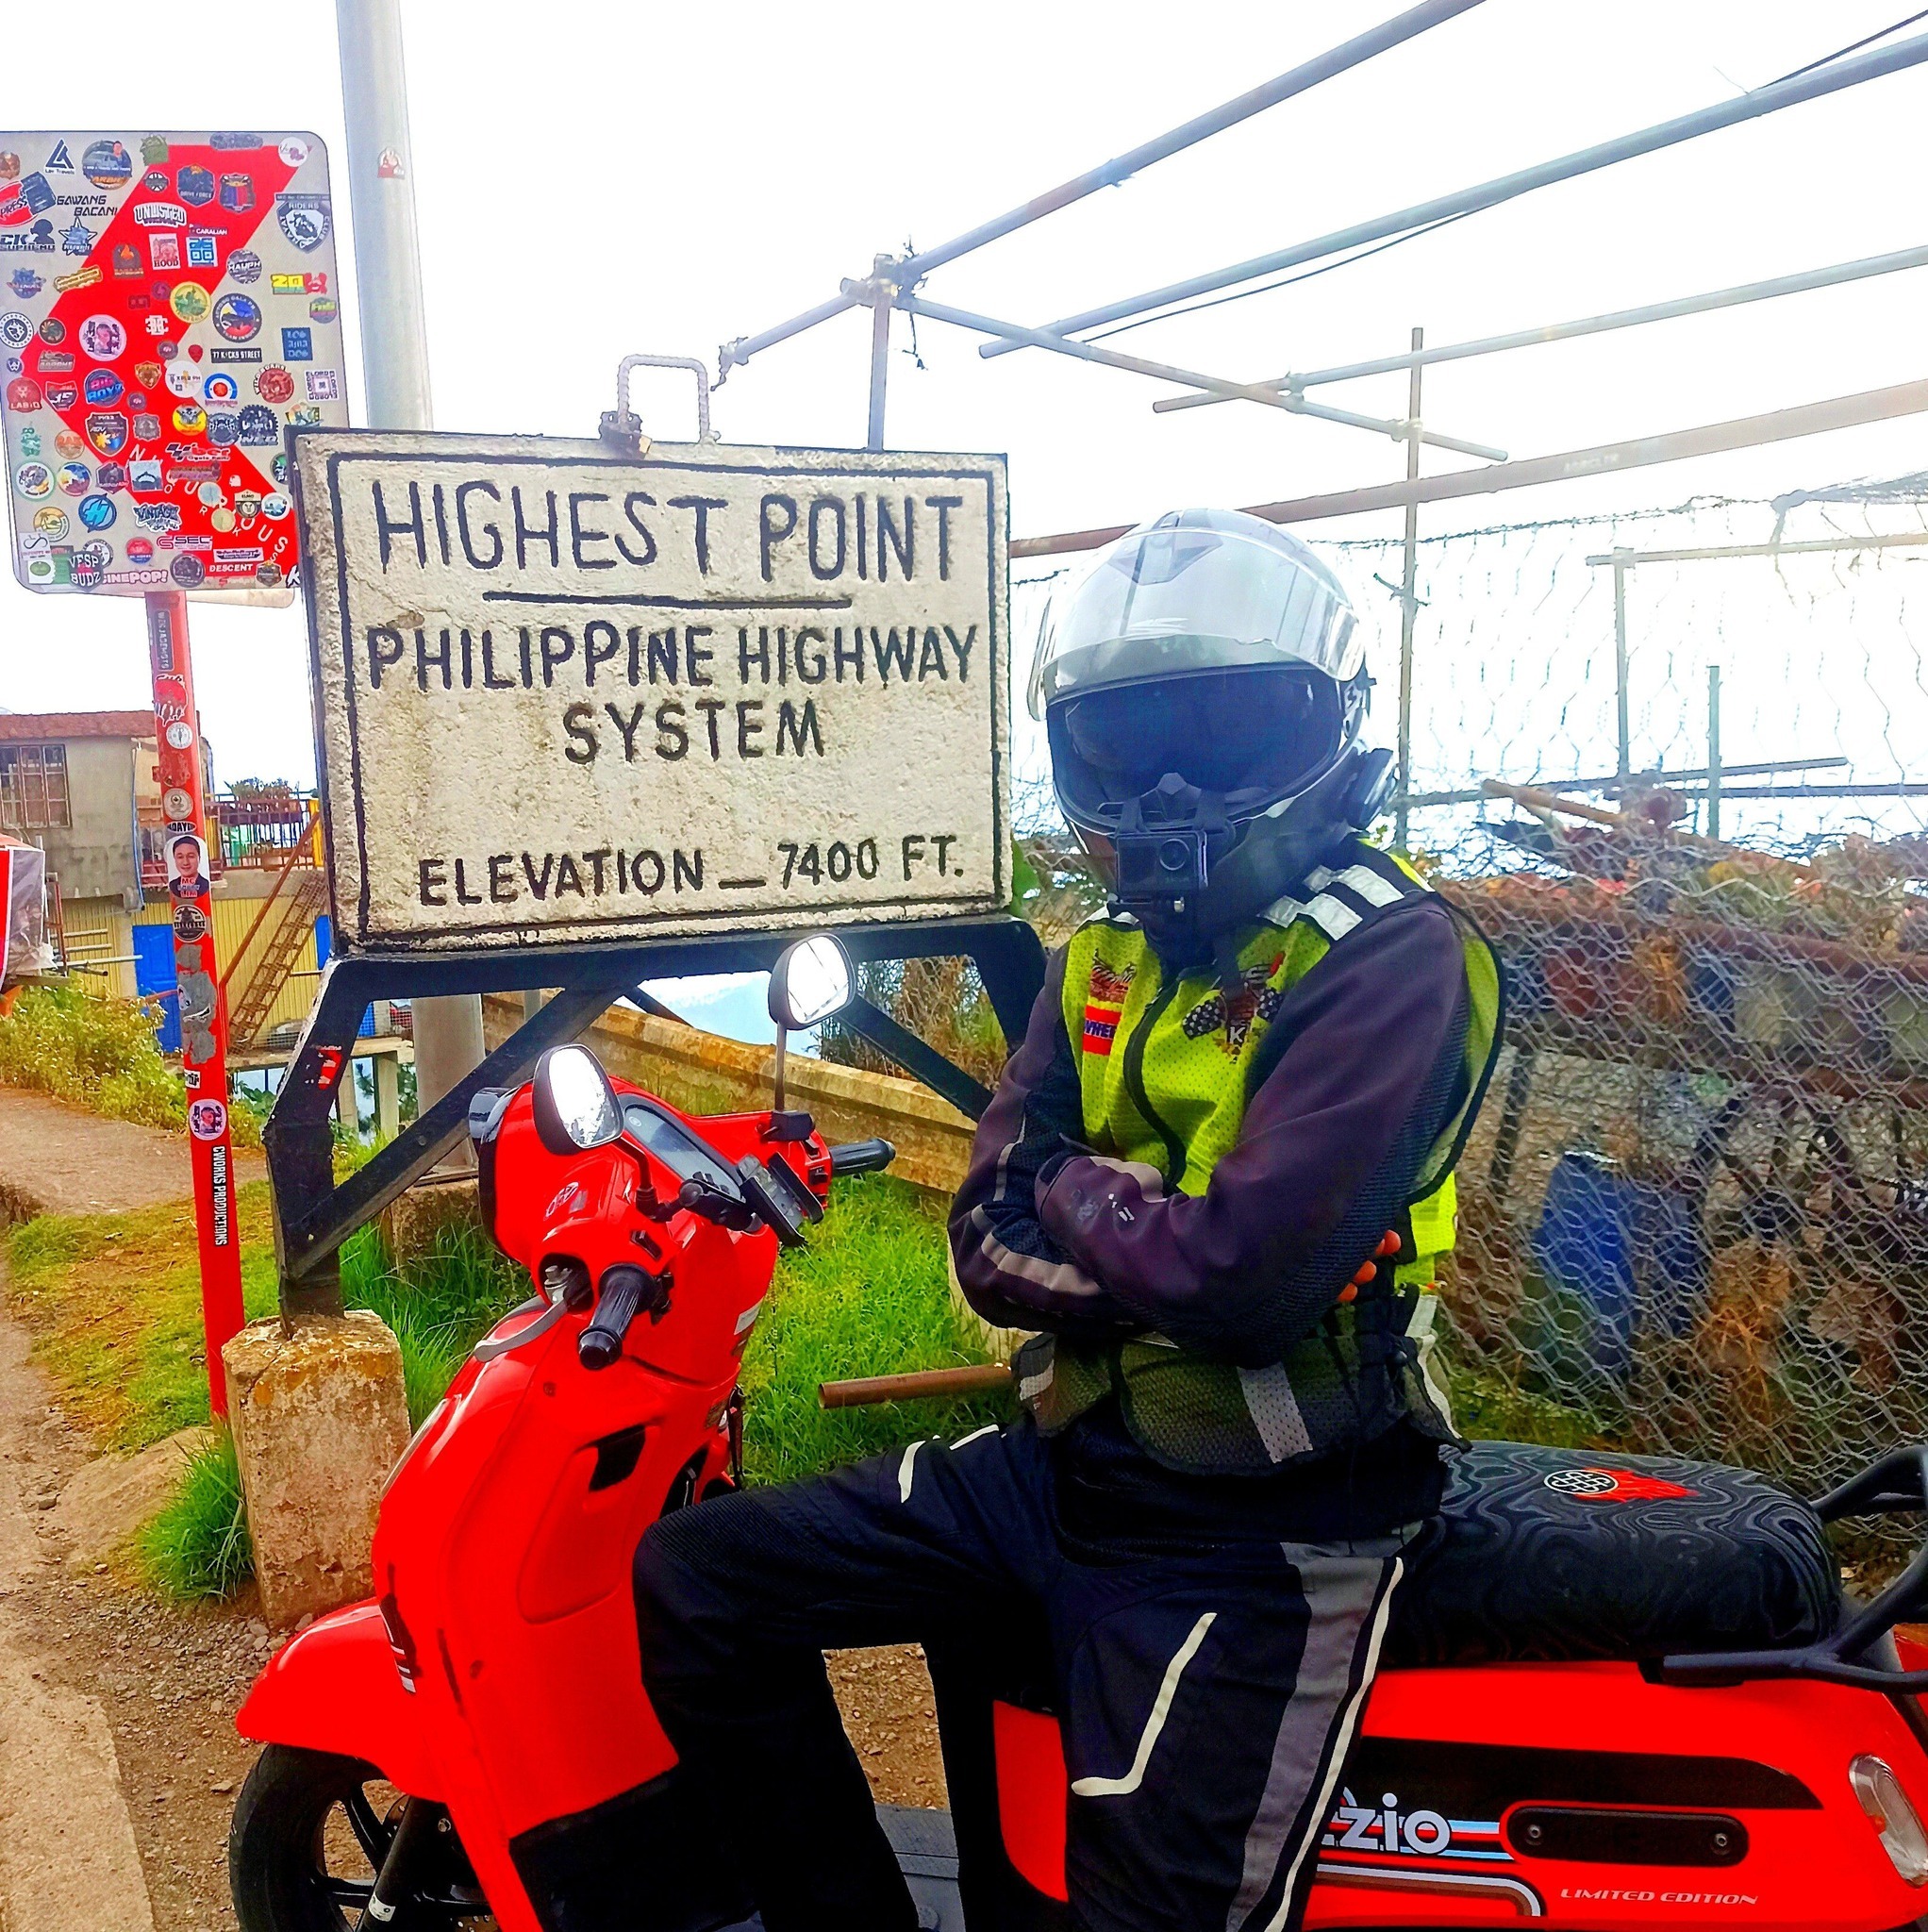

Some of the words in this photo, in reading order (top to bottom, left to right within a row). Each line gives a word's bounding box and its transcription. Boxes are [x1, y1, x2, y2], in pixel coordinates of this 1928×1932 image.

[57, 195, 107, 206] GAWANG
[75, 207, 118, 216] BACANI
[241, 350, 260, 358] STREET
[373, 479, 728, 575] HIGHEST
[759, 492, 963, 583] POINT
[71, 572, 100, 587] BUDZ
[366, 620, 714, 693] PHILIPPINE
[738, 625, 977, 690] HIGHWAY
[563, 697, 826, 765] SYSTEM
[418, 848, 705, 908] ELEVATION
[777, 837, 879, 891] 7400
[902, 834, 964, 882] FT.
[213, 1186, 227, 1245] PRODUCTIONS
[1561, 1889, 1654, 1902] LIMITED
[1660, 1891, 1758, 1905] EDITION
